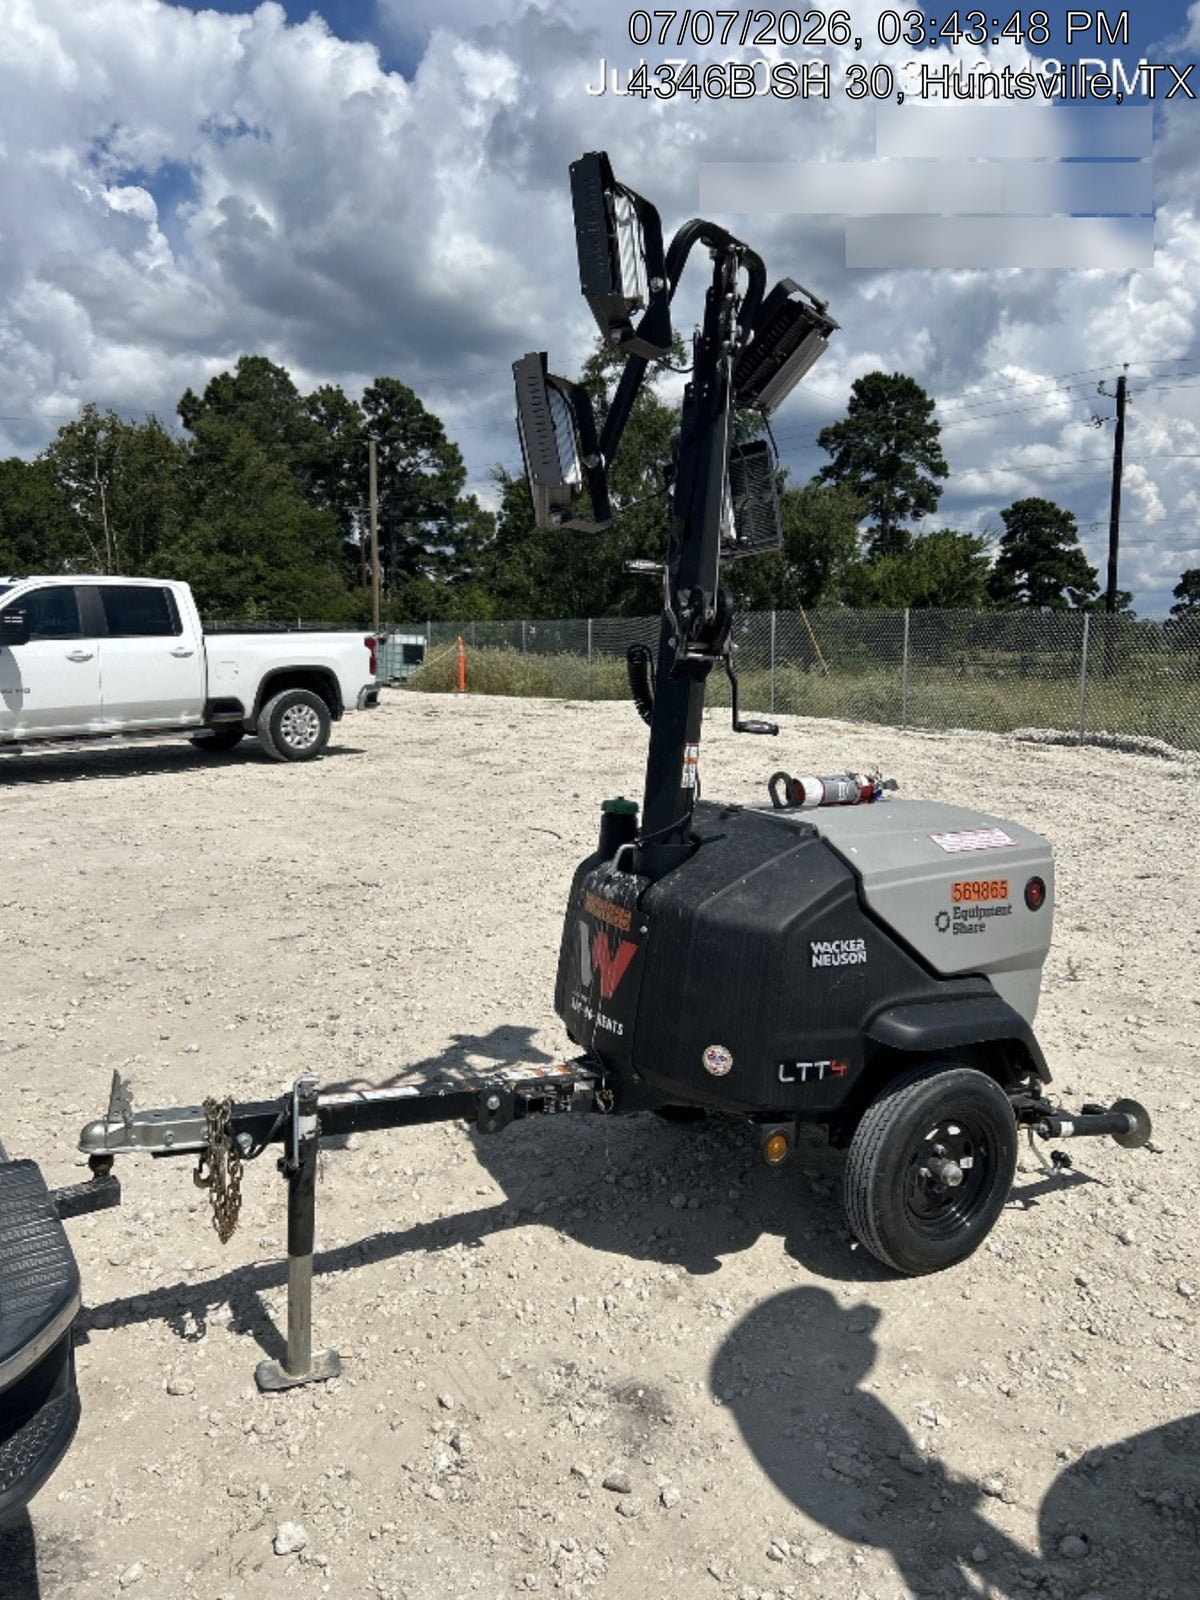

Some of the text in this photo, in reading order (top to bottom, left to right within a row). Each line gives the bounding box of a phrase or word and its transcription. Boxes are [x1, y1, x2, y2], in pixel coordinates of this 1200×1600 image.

[953, 880, 1008, 902] 569865
[952, 904, 1012, 921] Equipment
[952, 922, 986, 936] Share
[810, 938, 866, 955] WACKER
[811, 951, 867, 967] NEUSON
[778, 1059, 848, 1083] LTT4
